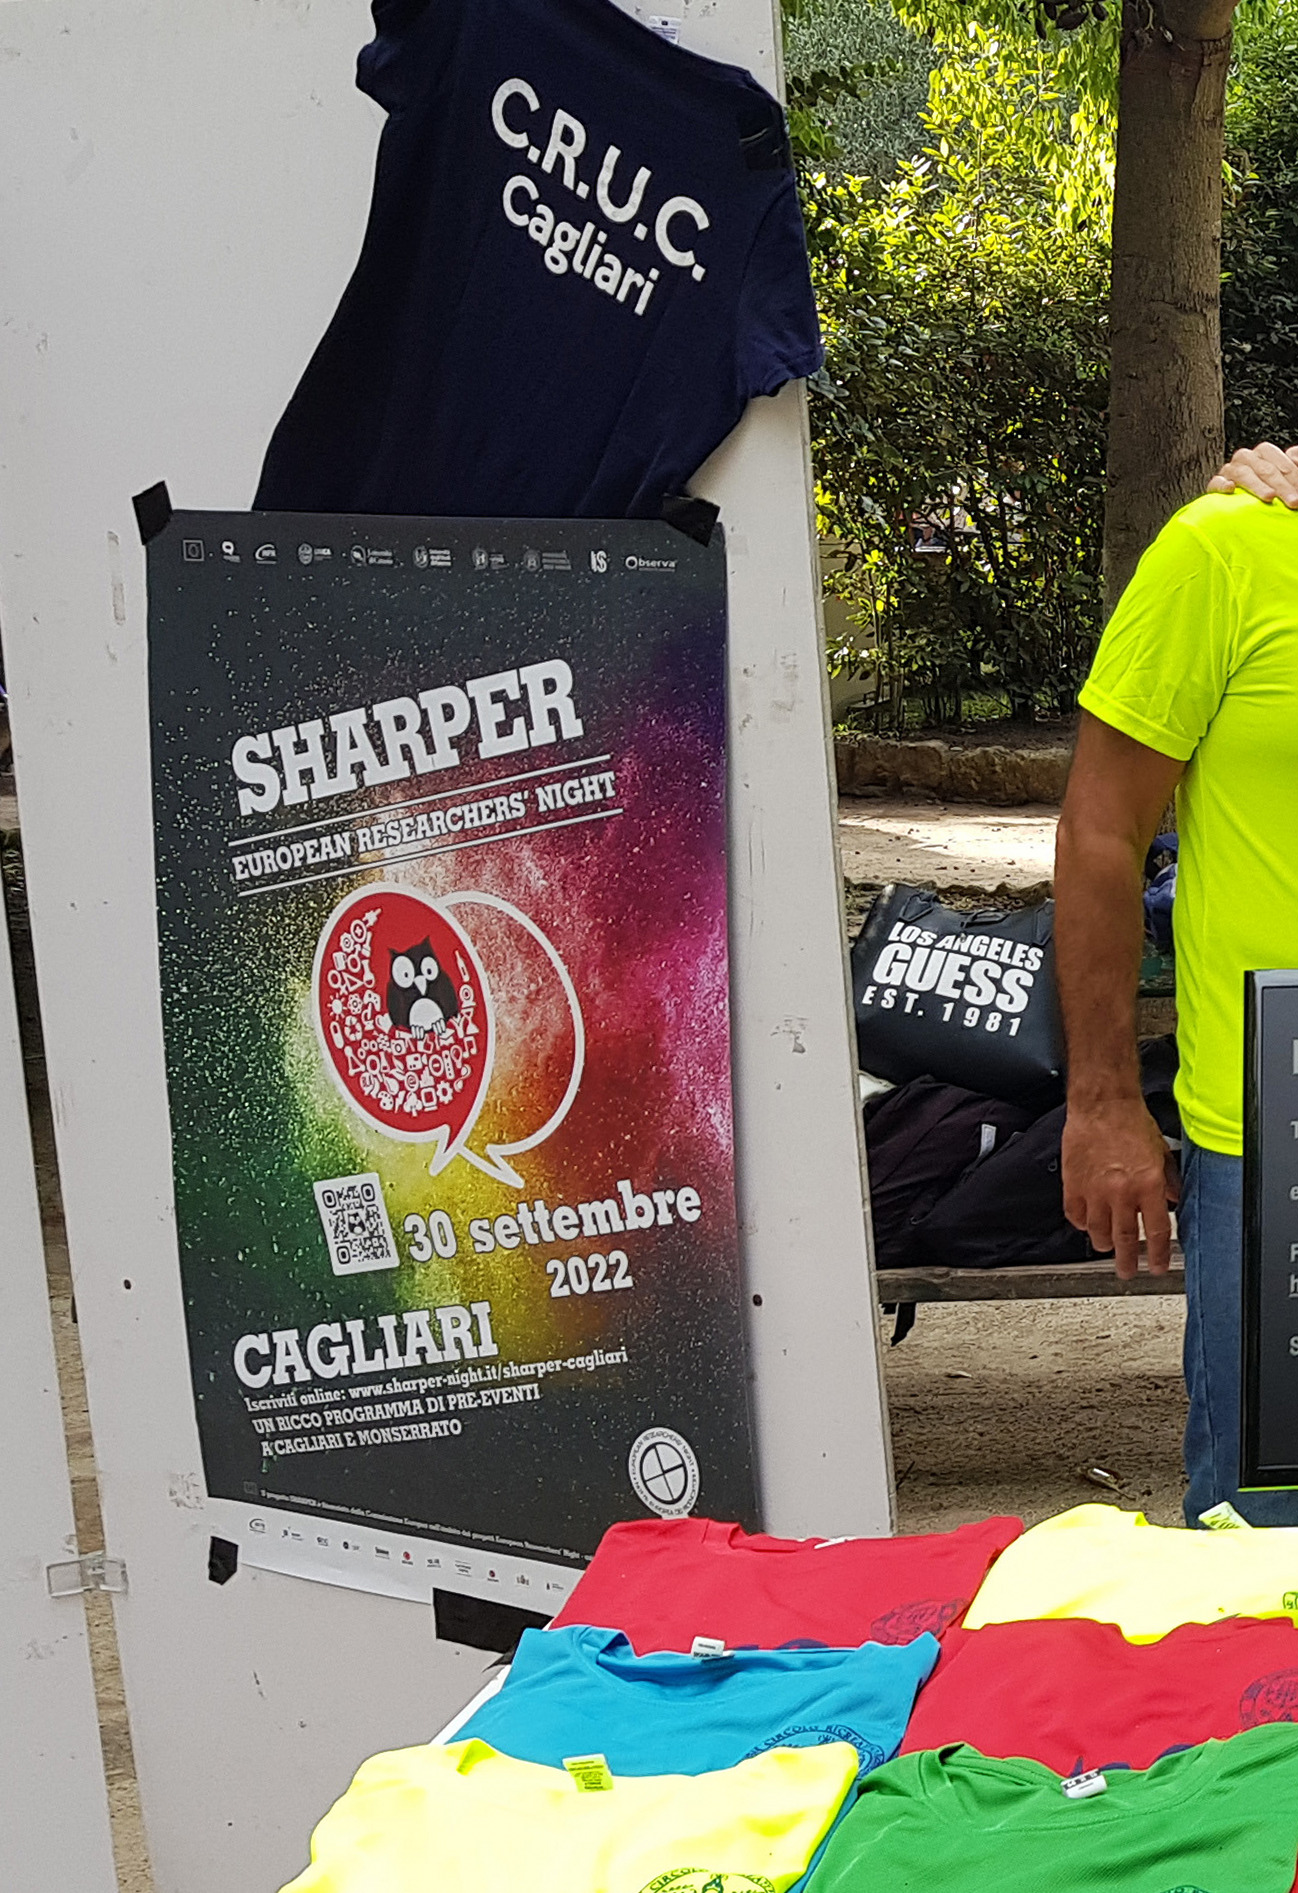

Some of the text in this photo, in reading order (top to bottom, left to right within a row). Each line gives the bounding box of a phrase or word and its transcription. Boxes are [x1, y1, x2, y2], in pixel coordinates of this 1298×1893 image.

[491, 78, 710, 281] C.R.U.C.
[502, 175, 659, 316] Cagliari
[232, 658, 584, 816] SHARPER
[232, 771, 616, 880] EUROPEAN RESEARCHERS' NIGHT
[872, 942, 1034, 1013] GUESS
[888, 921, 1043, 971] LOS ANGELES
[862, 985, 1021, 1036] EST. 1981
[404, 1179, 702, 1262] 30 settembre
[546, 1250, 634, 1298] 2022
[233, 1301, 498, 1389] CAGLIARI
[244, 1346, 629, 1412] Iscriviti online: www.sharper-night.it/sharper-cagliari
[252, 1383, 541, 1433] UN RICCO PROGRAMMA DI PRE-EVENTI
[261, 1418, 462, 1457] A CAGLIARI E MONSERRATO
